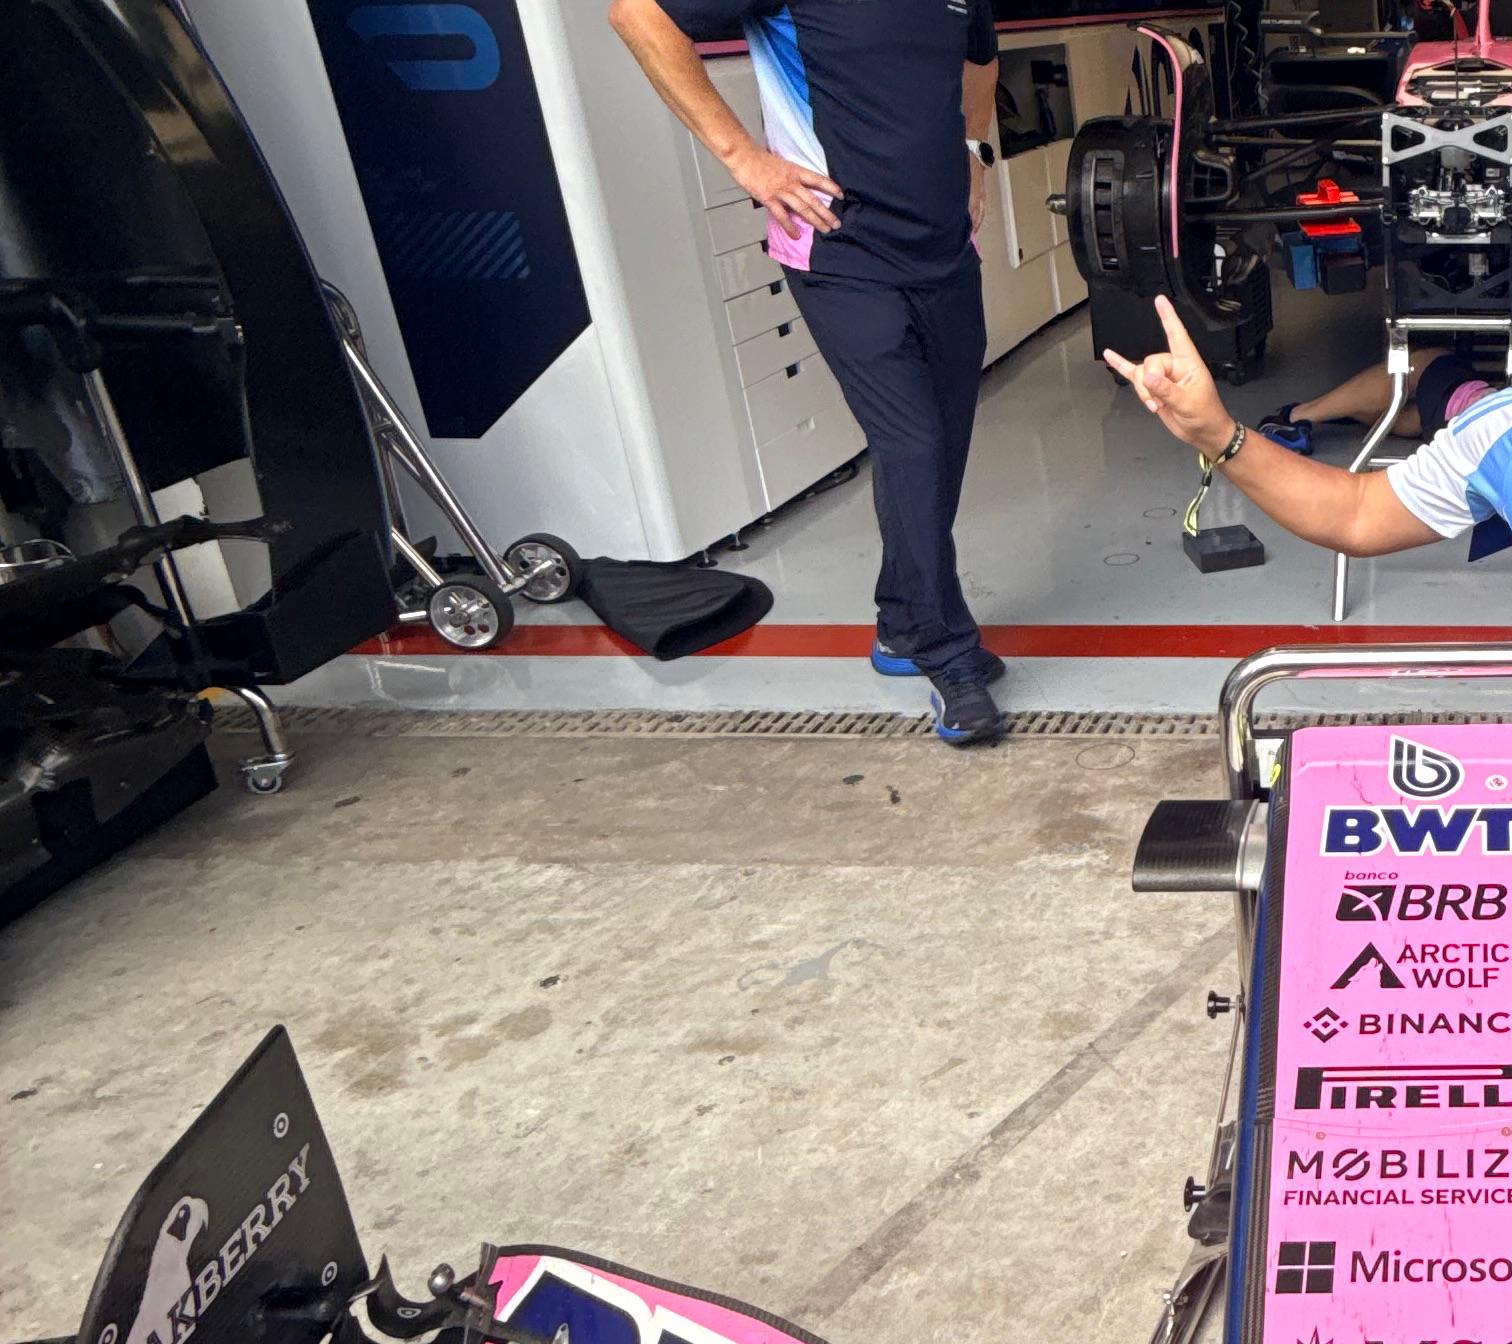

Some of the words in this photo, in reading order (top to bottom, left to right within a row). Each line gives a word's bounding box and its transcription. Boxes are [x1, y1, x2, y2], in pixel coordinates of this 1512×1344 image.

[1344, 870, 1399, 882] banco
[1396, 883, 1508, 922] BRB
[1396, 942, 1511, 965] ARCTIC
[1411, 967, 1500, 990] WOLF
[1283, 1189, 1415, 1206] FINANCIAL
